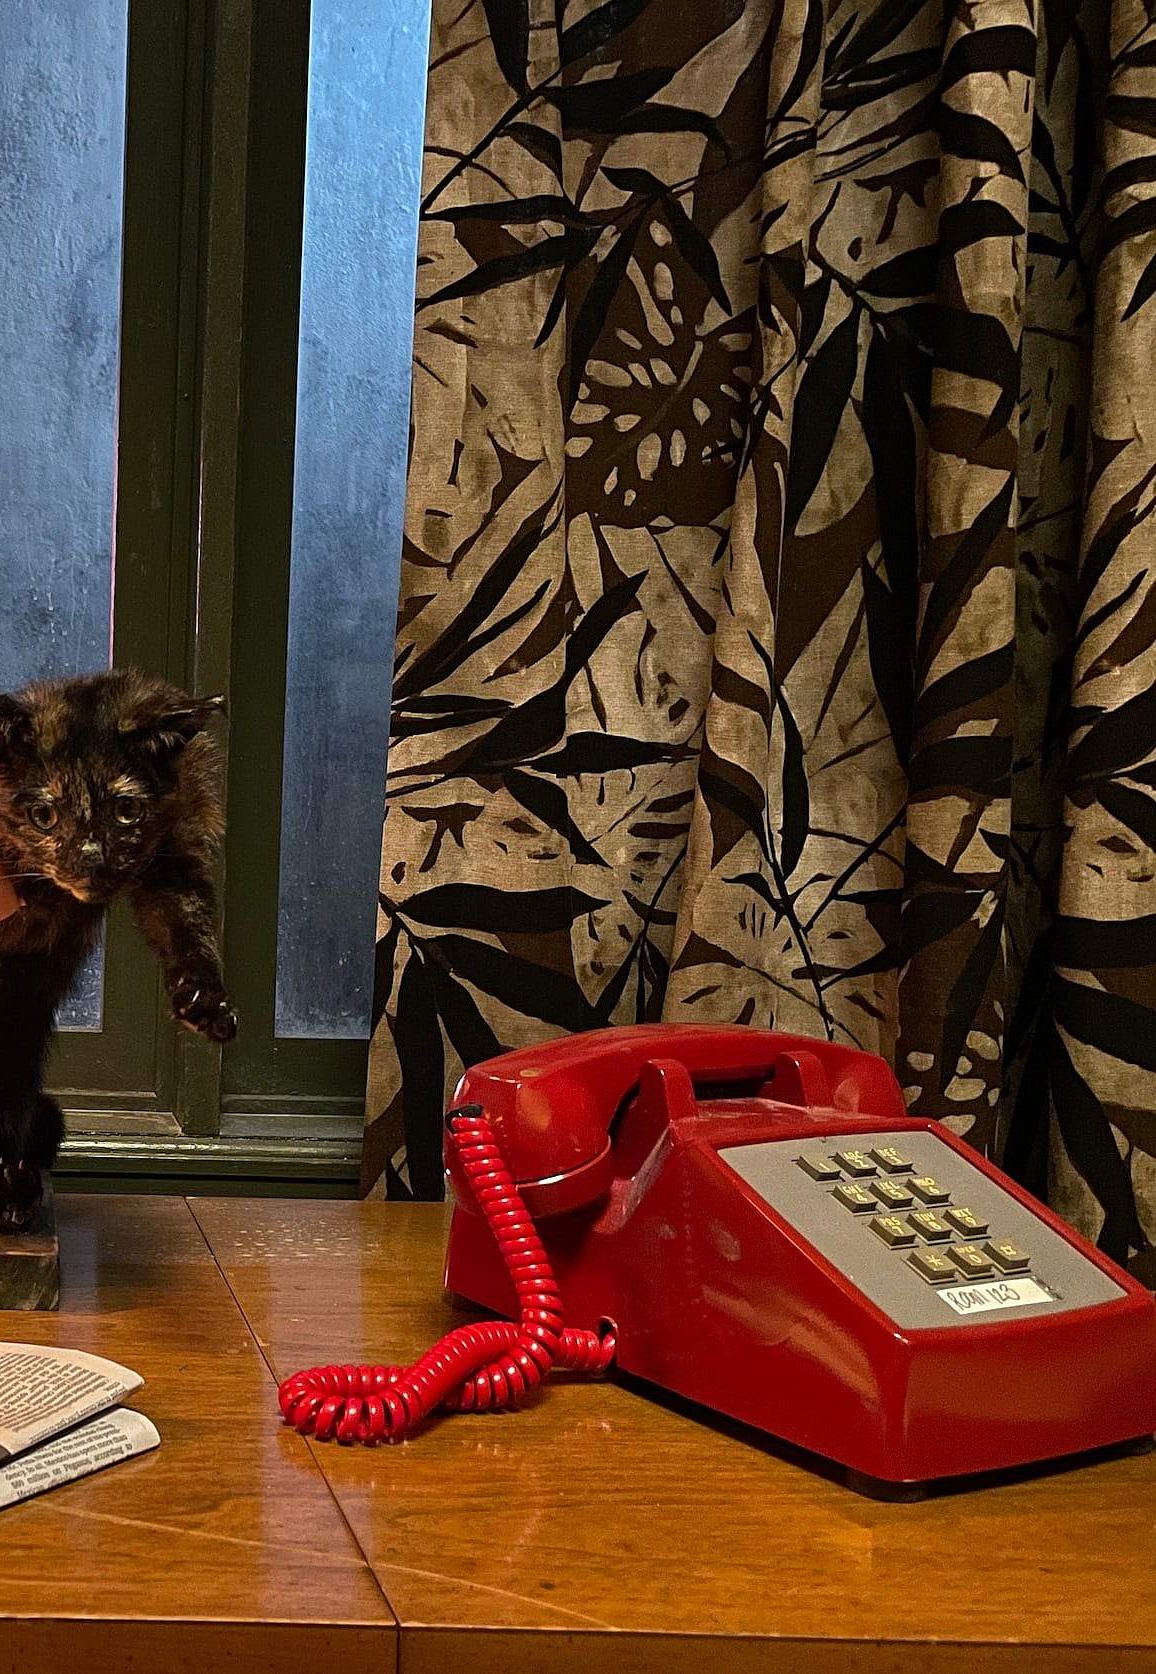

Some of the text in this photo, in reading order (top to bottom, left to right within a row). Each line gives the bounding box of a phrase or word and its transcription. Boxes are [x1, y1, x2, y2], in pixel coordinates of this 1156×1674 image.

[844, 1150, 864, 1161] ABC
[877, 1147, 897, 1157] DEF
[819, 1162, 830, 1171] 1
[855, 1159, 869, 1168] 2
[843, 1184, 864, 1195] GHI
[879, 1181, 900, 1191] JKL
[928, 1186, 940, 1195] 6
[856, 1193, 868, 1202] 4
[889, 1189, 904, 1198] 5
[914, 1212, 936, 1222] TUV
[965, 1216, 977, 1226] 9
[891, 1225, 904, 1235] 7
[928, 1221, 942, 1230] 8
[969, 1254, 982, 1264] 0
[985, 1283, 1021, 1305] 123
